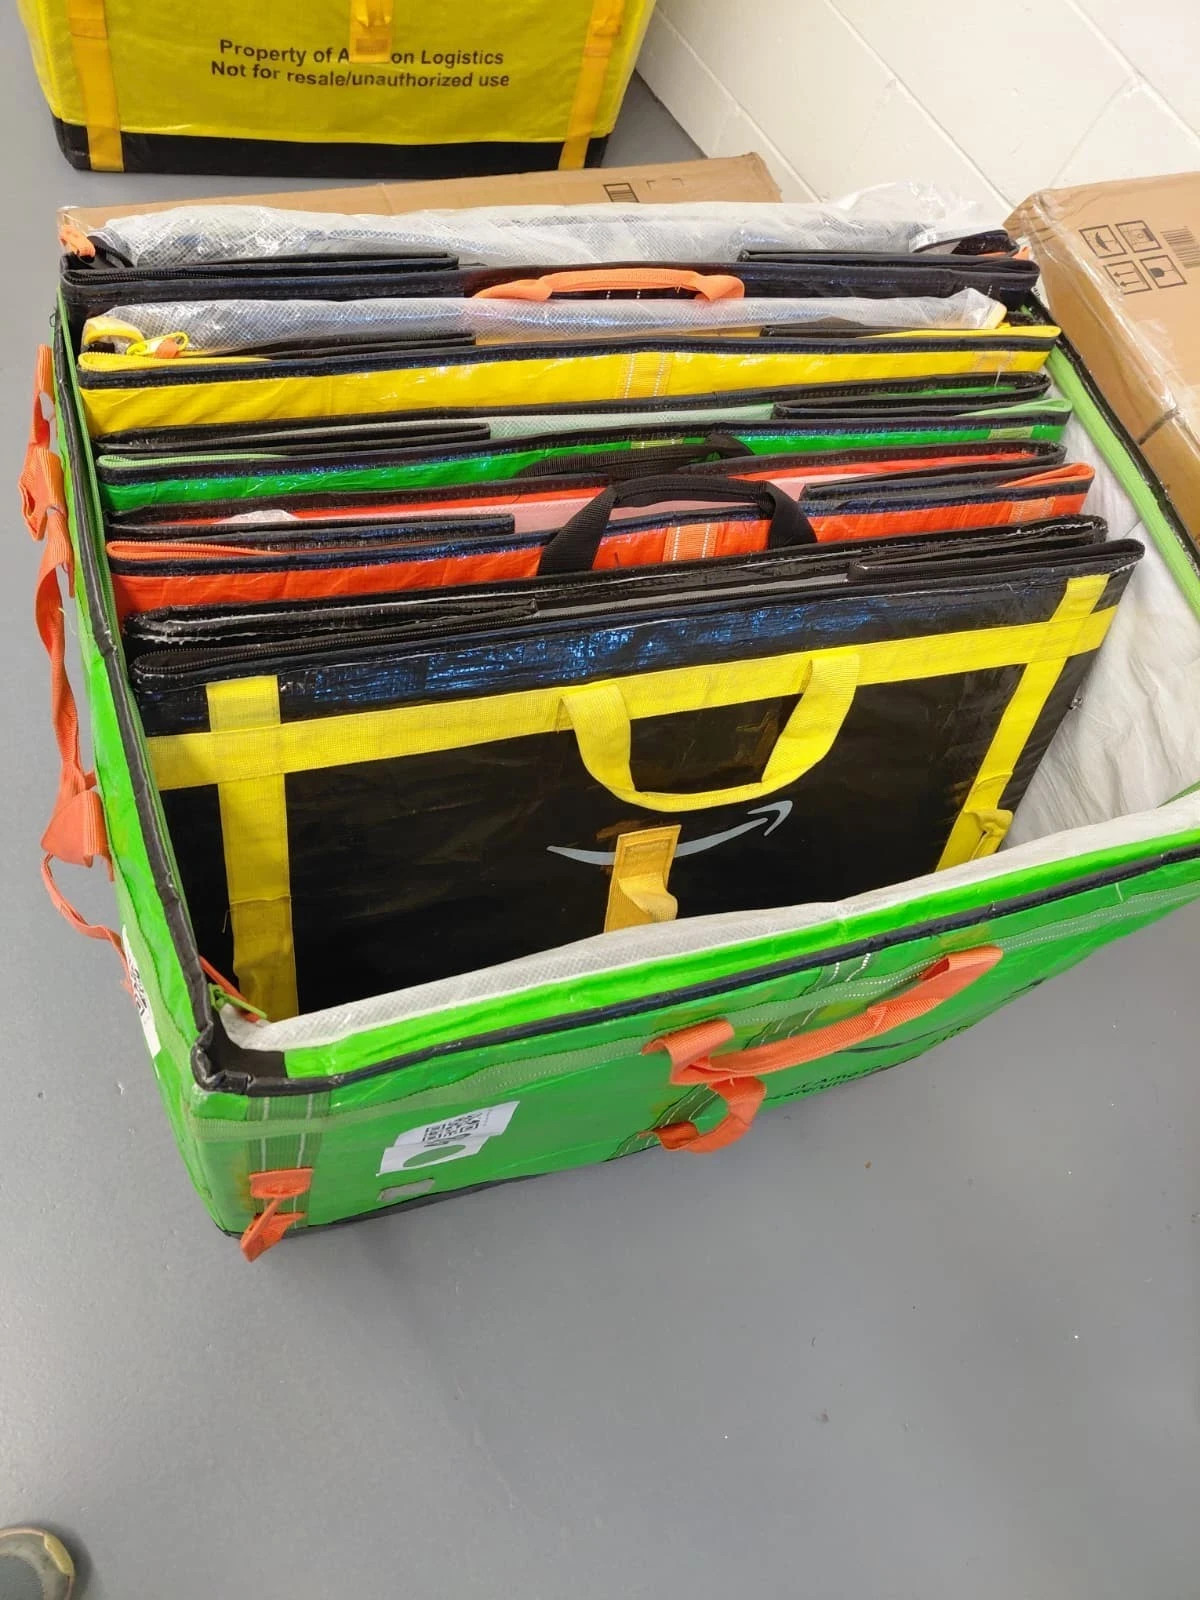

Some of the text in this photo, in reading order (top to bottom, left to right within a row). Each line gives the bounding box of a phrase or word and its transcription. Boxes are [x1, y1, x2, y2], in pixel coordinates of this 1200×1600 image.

[219, 39, 504, 69] Property of Aon Logistics
[211, 60, 510, 87] Not for resale/unauthorized use
